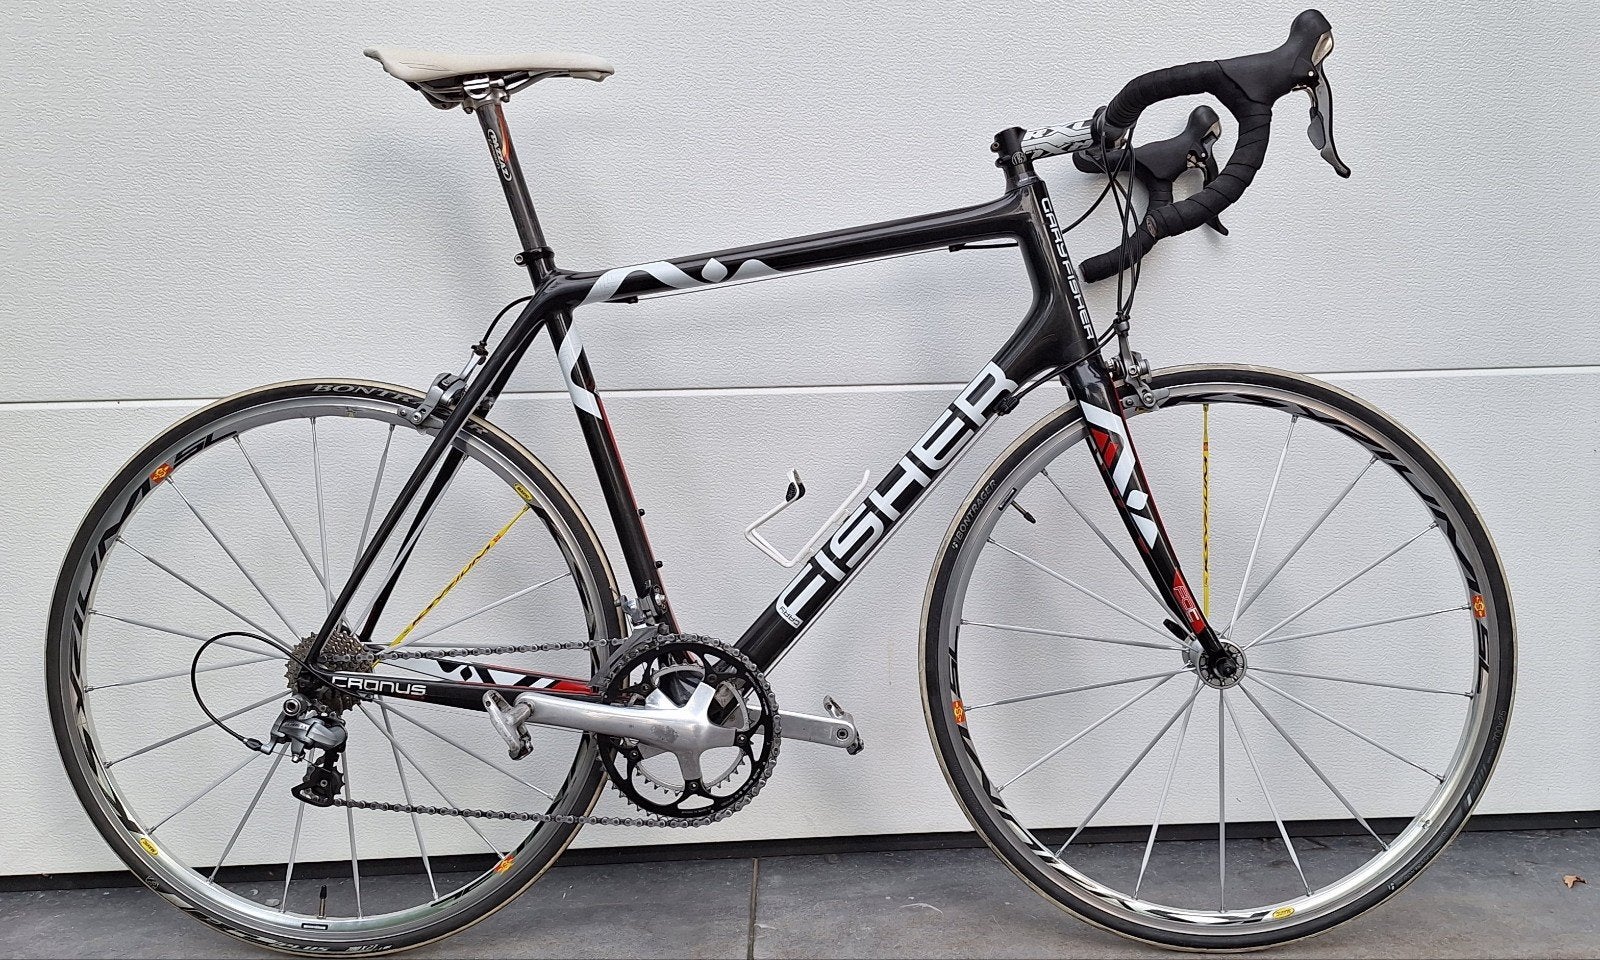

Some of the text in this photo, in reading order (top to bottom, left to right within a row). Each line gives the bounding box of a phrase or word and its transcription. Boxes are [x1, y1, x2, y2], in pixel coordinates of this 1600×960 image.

[1041, 198, 1094, 340] GARY FISHER
[173, 430, 237, 469] SL
[777, 361, 1018, 628] FISHER
[955, 479, 996, 540] BONTRAGER
[780, 606, 801, 626] GARY
[332, 676, 427, 696] CRONUS
